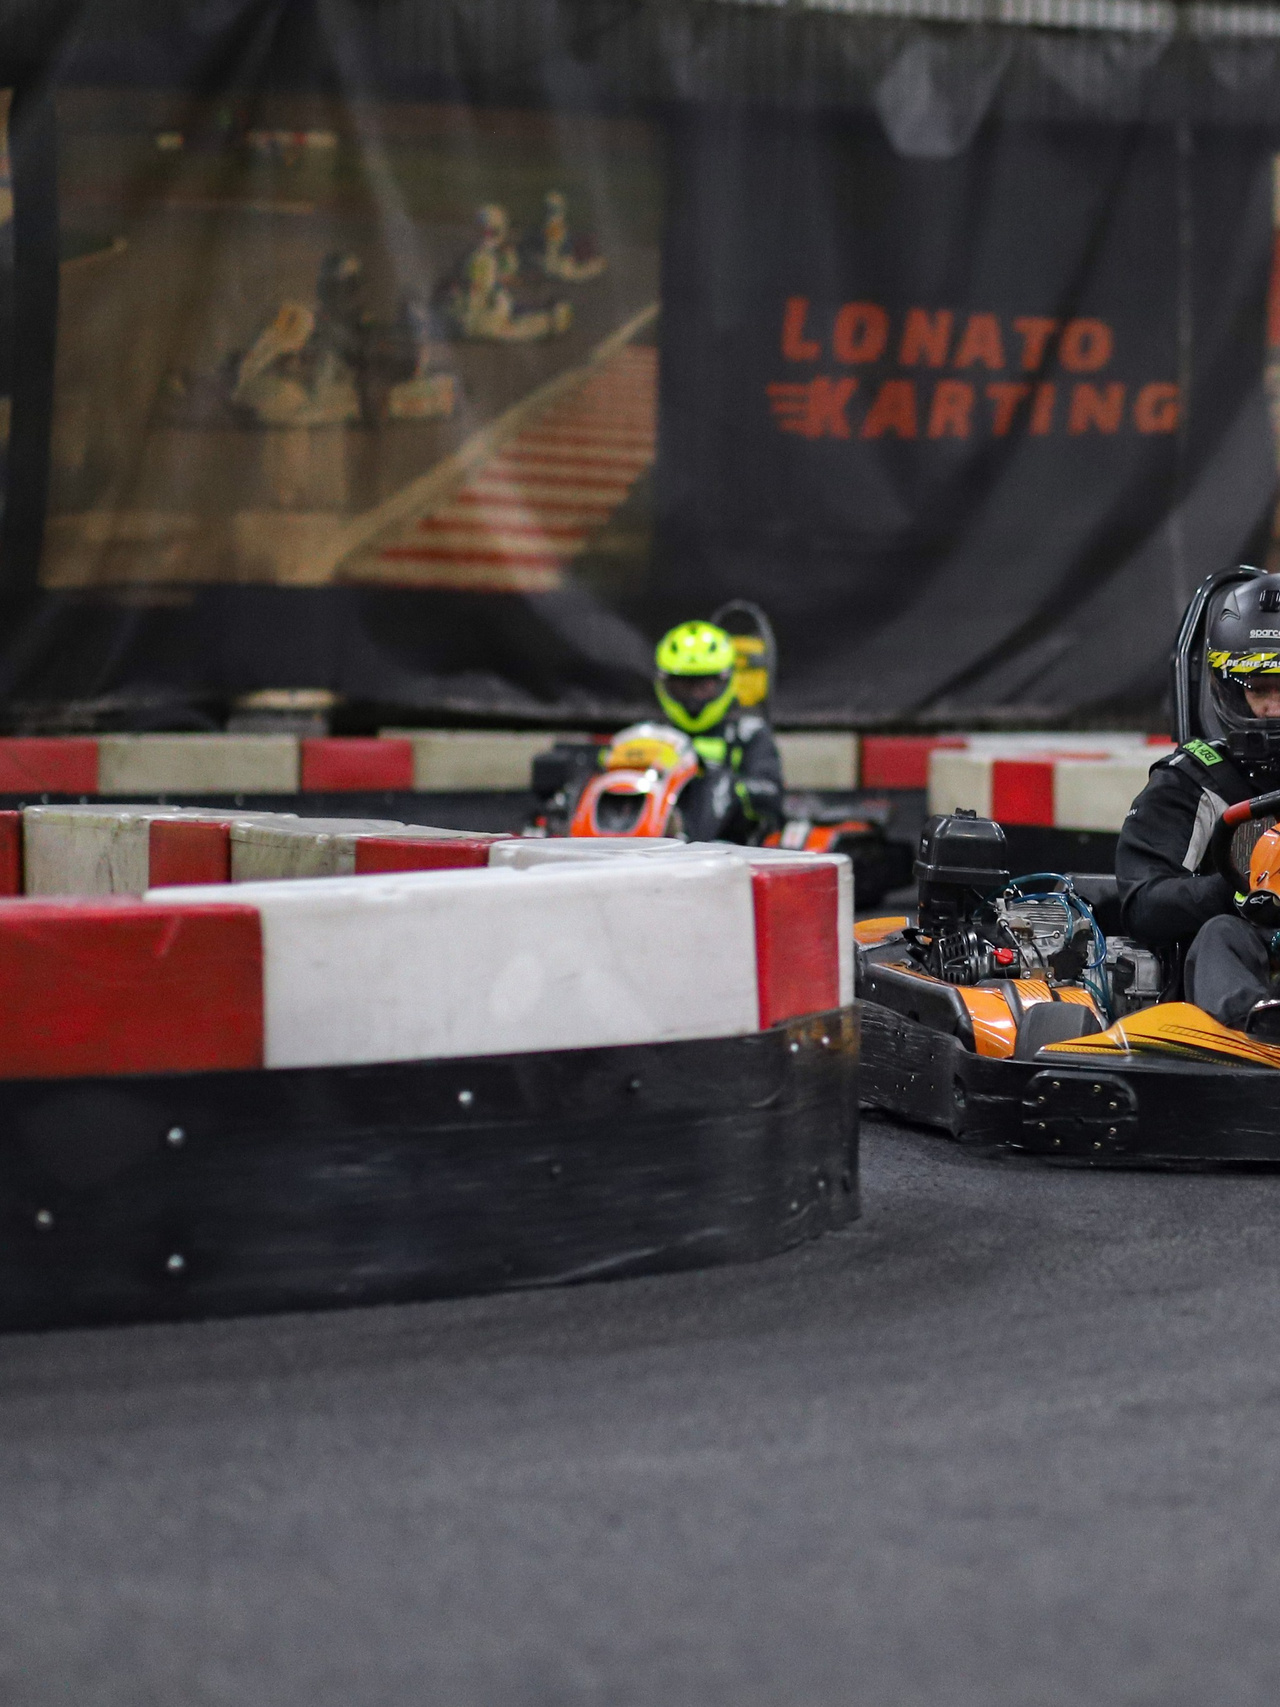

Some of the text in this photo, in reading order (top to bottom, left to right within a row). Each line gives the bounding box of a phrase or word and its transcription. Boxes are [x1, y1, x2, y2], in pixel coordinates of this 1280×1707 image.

[781, 296, 1114, 372] LONATO
[796, 375, 1183, 440] KARTING
[1226, 659, 1238, 667] BE
[1240, 660, 1261, 668] THE
